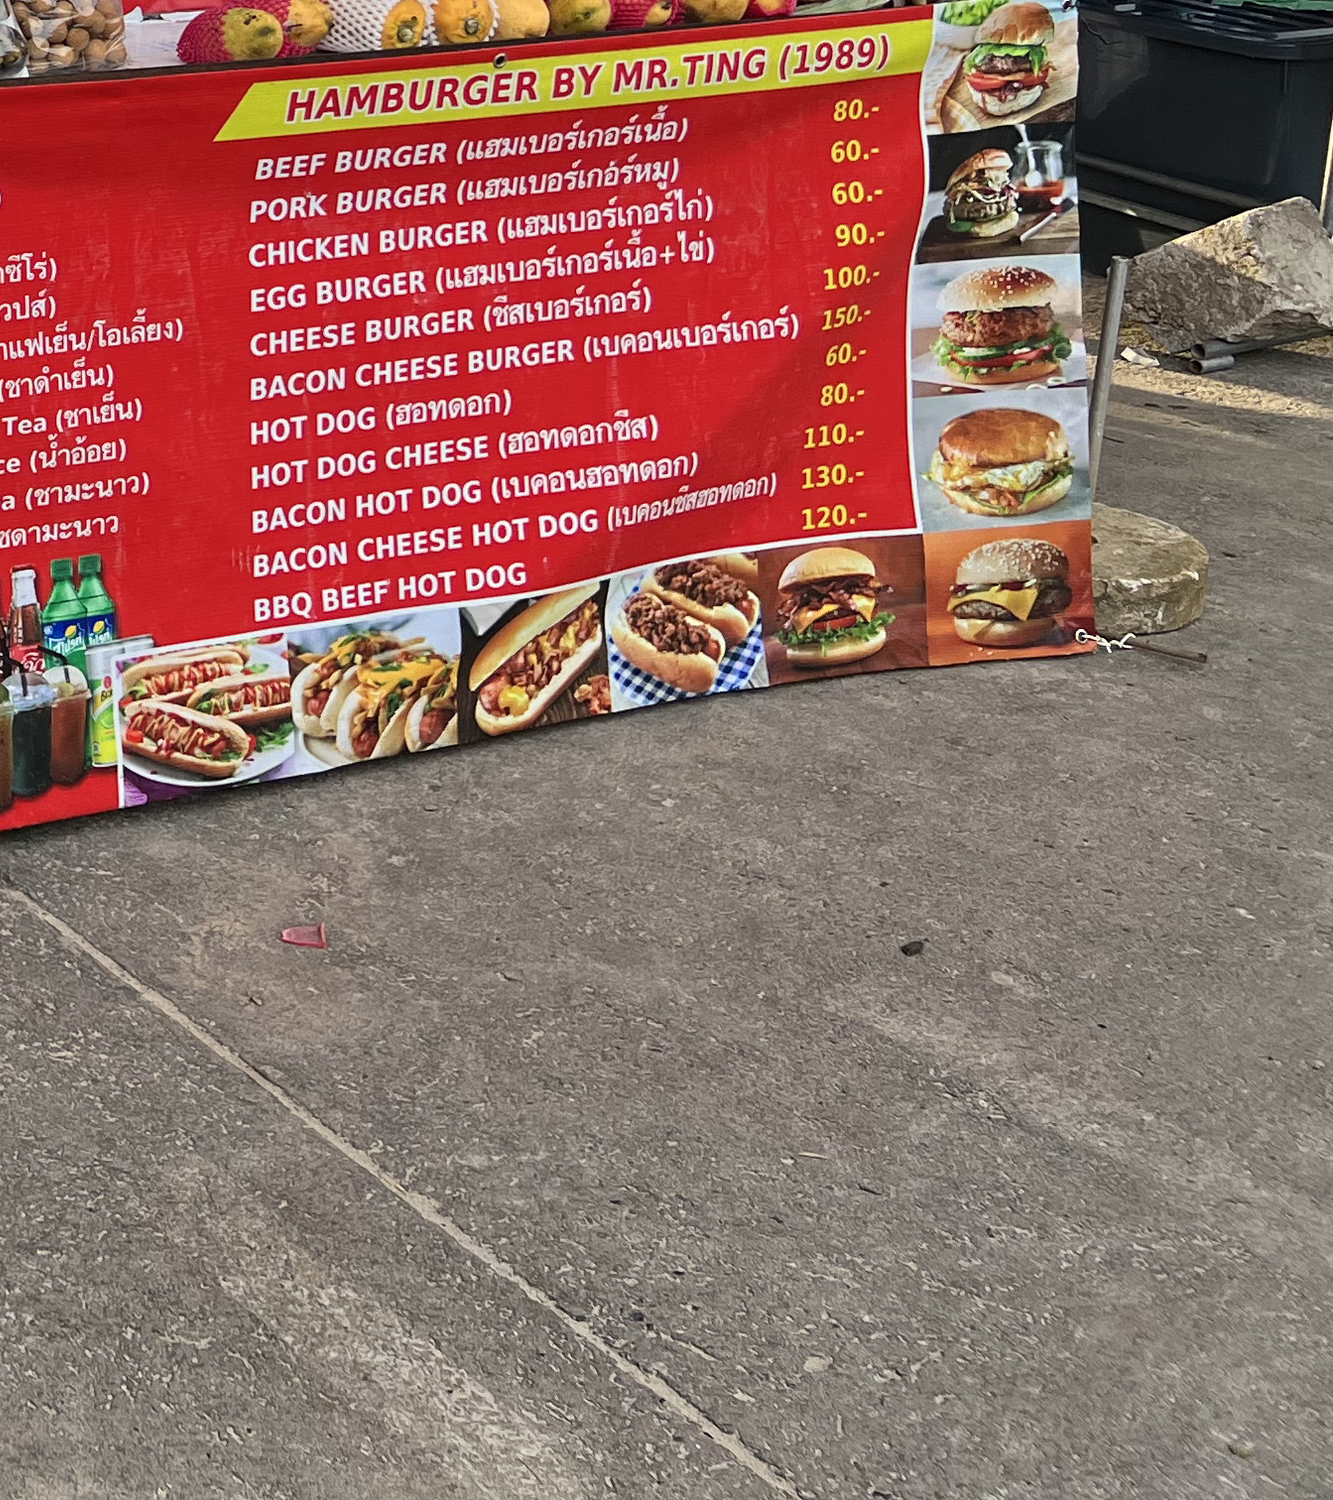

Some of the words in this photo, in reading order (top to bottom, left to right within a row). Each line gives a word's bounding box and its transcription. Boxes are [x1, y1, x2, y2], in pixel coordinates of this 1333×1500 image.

[286, 73, 537, 122] HAMBURGER
[552, 63, 601, 98] BY
[612, 48, 767, 93] MR.TING
[778, 34, 891, 80] (1989)
[249, 191, 329, 224] PORK
[336, 182, 447, 215] BURGER
[830, 139, 880, 164] 60.-
[254, 153, 327, 181] BEEF
[334, 142, 447, 173] BURGER
[456, 111, 689, 165] (แฮมเบอร์เกอร์เนื้อ)
[833, 98, 880, 122] 80.-
[248, 232, 370, 268] CHICKEN
[379, 219, 489, 254] BURGER
[497, 187, 714, 246] (แฮมเบอร์เกอร์ไก่)
[832, 180, 884, 205] 60.-
[250, 283, 307, 313] EGG
[316, 270, 427, 305] BURGER
[435, 230, 715, 295] (แฮมเบอร์เกอร์เนื้อ+ไข่)
[835, 222, 885, 247] 90.-
[249, 322, 356, 357] CHEESE
[365, 308, 475, 343] BURGER
[483, 278, 652, 332] (ชีสเบอร์เกอร์)
[823, 264, 880, 291] 100.-
[250, 366, 346, 401] BACON
[355, 352, 459, 387] CHEESE
[467, 339, 575, 374] BURGER
[583, 304, 800, 363] (เบคอนเบอร์เกอร์)
[821, 304, 871, 331] 150.-
[1, 415, 47, 436] Tea
[55, 390, 143, 433] (ชาเย็น)
[250, 414, 309, 446] HOT
[316, 406, 376, 436] DOG
[385, 388, 512, 431] (ฮอทดอก)
[825, 342, 867, 367] 60.-
[251, 459, 309, 490] HOT
[317, 449, 377, 480] DOG
[385, 435, 489, 470] CHEESE
[498, 414, 659, 460] (ฮอทดอกชีส)
[820, 382, 865, 407] 80.-
[25, 471, 150, 511] (ชามะนาว)
[29, 435, 127, 474] (น้ำอ้อย)
[252, 497, 346, 534] BACON
[355, 488, 414, 519] HOT
[421, 479, 482, 510] DOG
[491, 451, 699, 504] (เบคอนฮอทดอก)
[803, 423, 865, 449] 110.-
[253, 541, 348, 578] BACON
[357, 525, 463, 562] CHEESE
[472, 517, 530, 547] HOT
[537, 508, 599, 539] DOG
[607, 472, 777, 532] (เบคอนชีสฮอทดอก)
[801, 463, 865, 490] 130.-
[253, 591, 314, 623] BBQ
[321, 578, 391, 613] BEEF
[397, 570, 457, 601] HOT
[465, 562, 527, 592] DOG
[801, 504, 868, 531] 120.-
